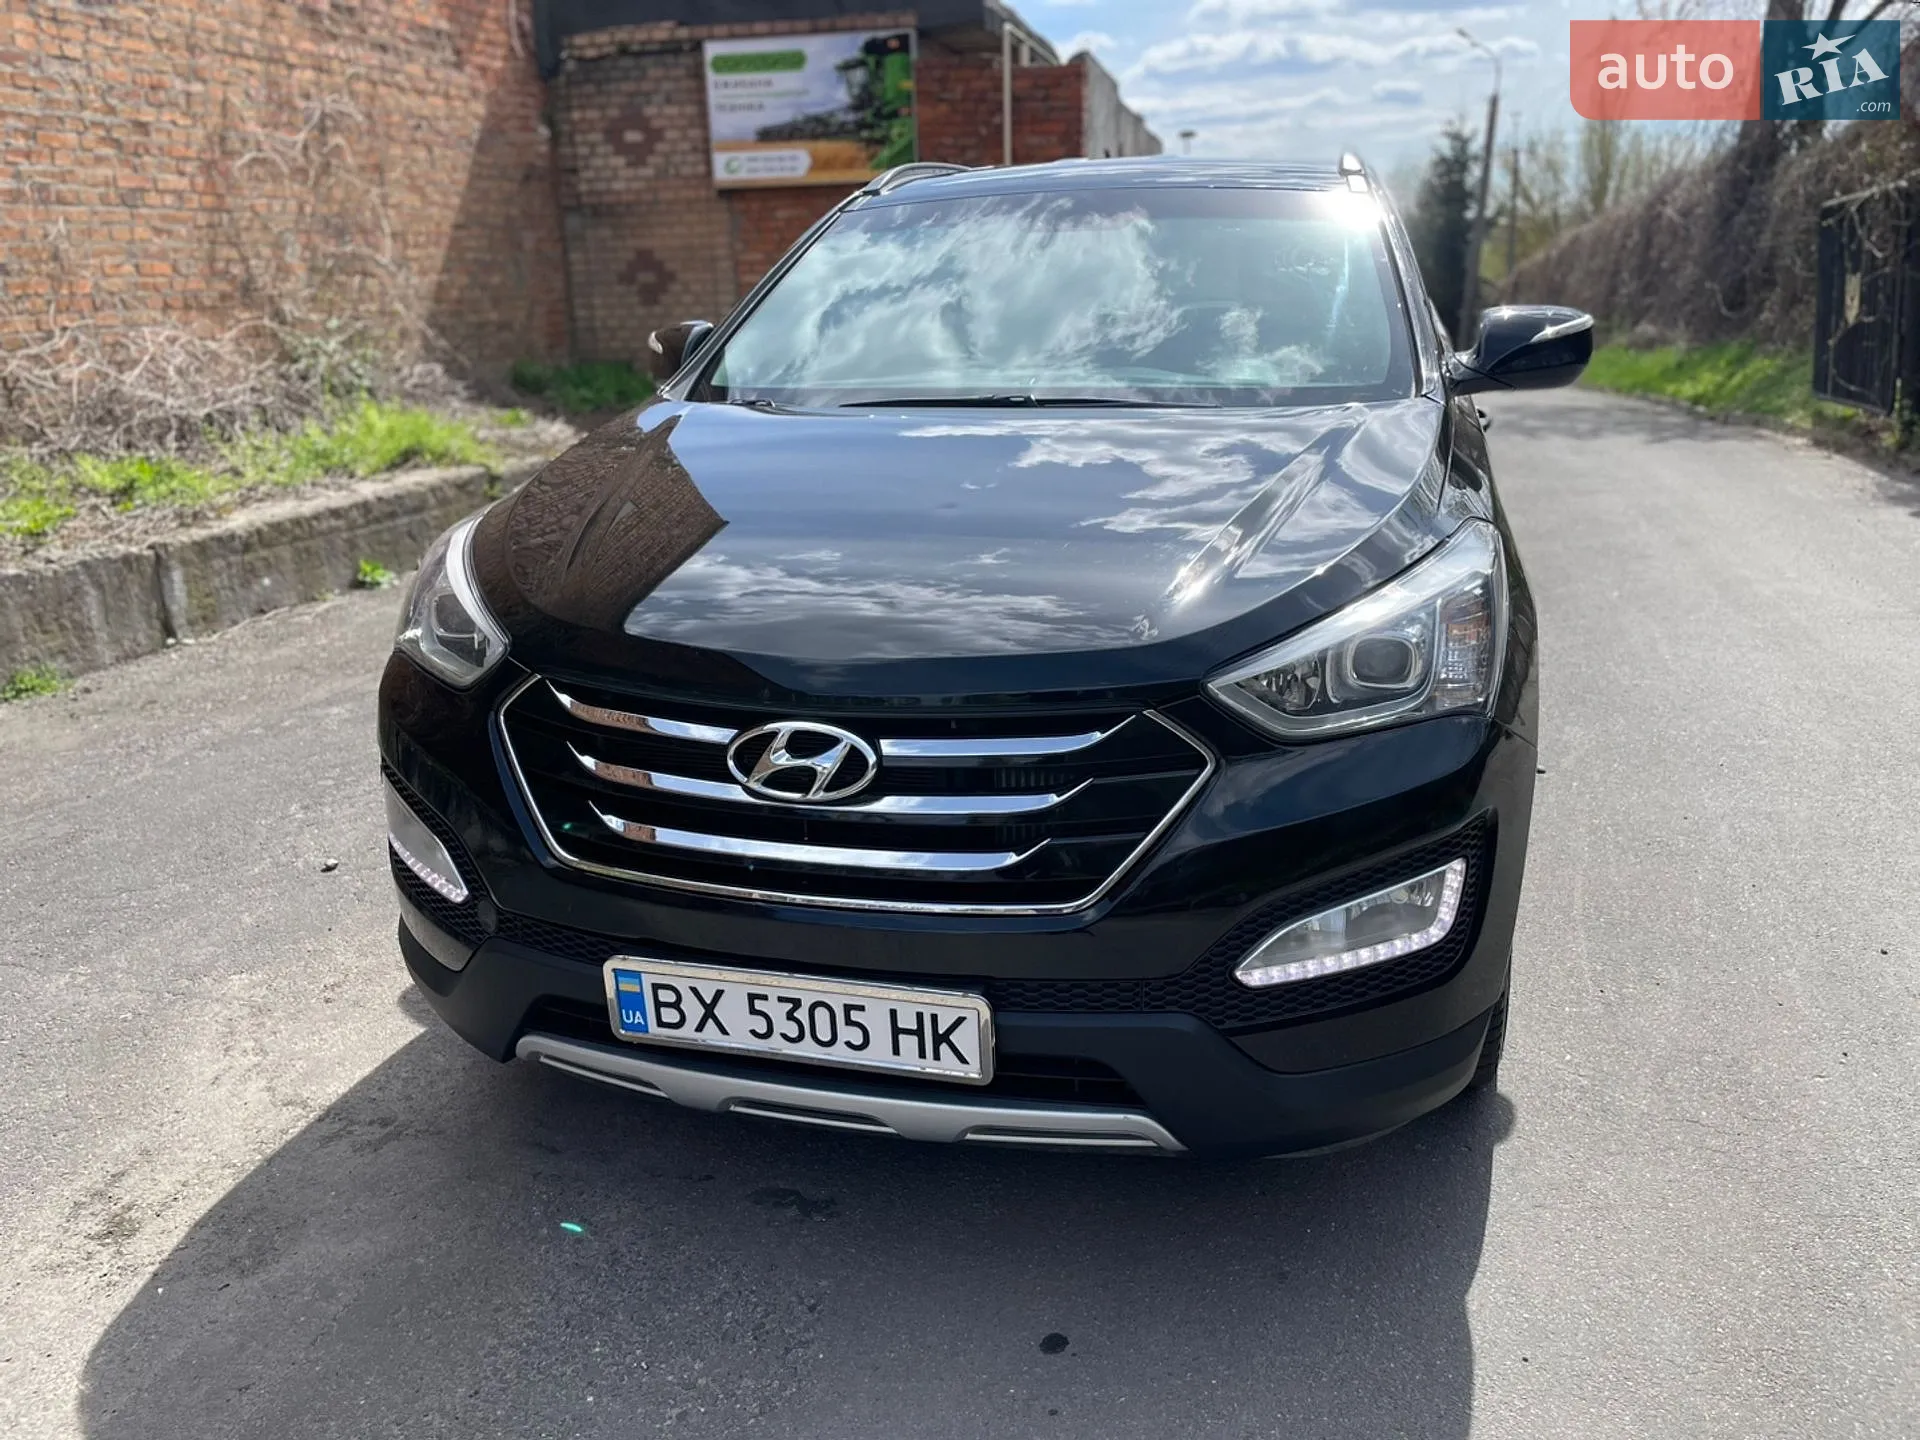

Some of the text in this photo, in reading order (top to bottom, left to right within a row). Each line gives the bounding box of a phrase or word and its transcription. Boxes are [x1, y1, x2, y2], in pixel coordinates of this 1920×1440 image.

[621, 1008, 645, 1026] UA
[651, 982, 970, 1065] BX 5305 HK
